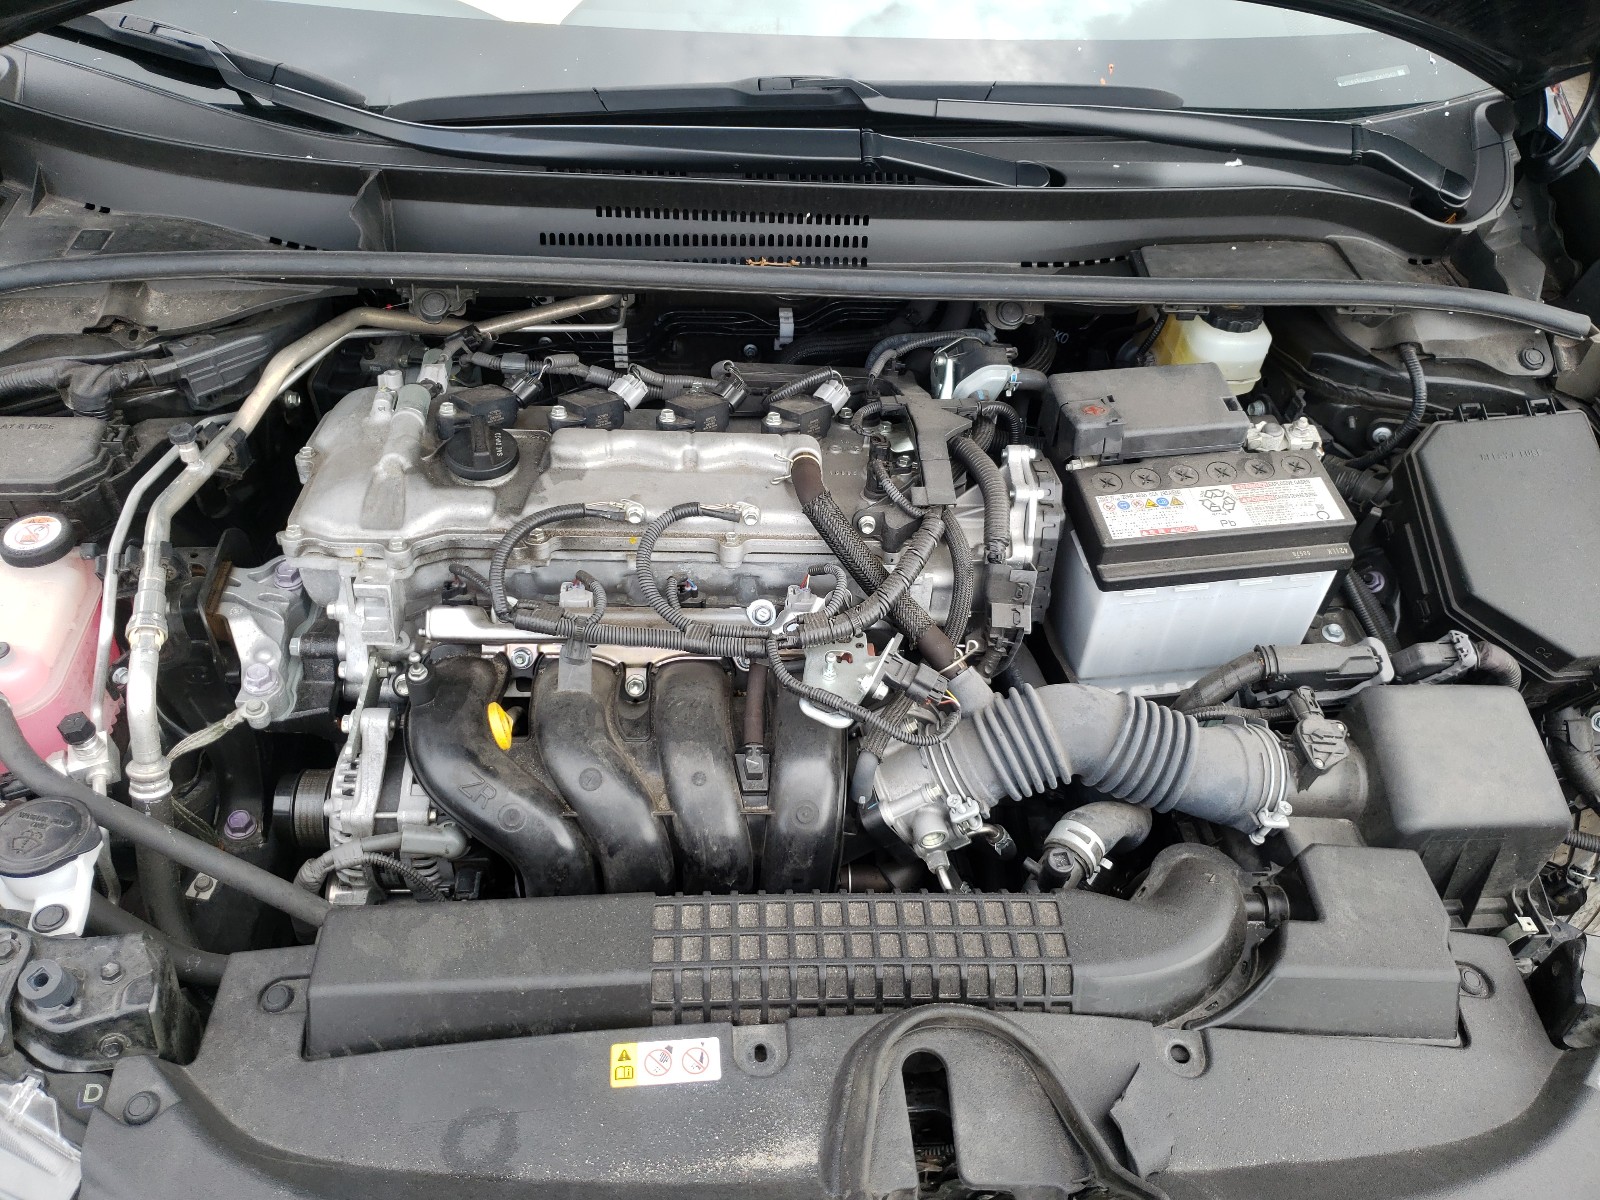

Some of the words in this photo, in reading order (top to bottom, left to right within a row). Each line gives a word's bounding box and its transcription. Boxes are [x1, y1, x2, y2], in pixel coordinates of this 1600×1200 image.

[1220, 519, 1237, 528] Pb
[458, 771, 497, 810] ZR
[82, 1083, 104, 1103] D
